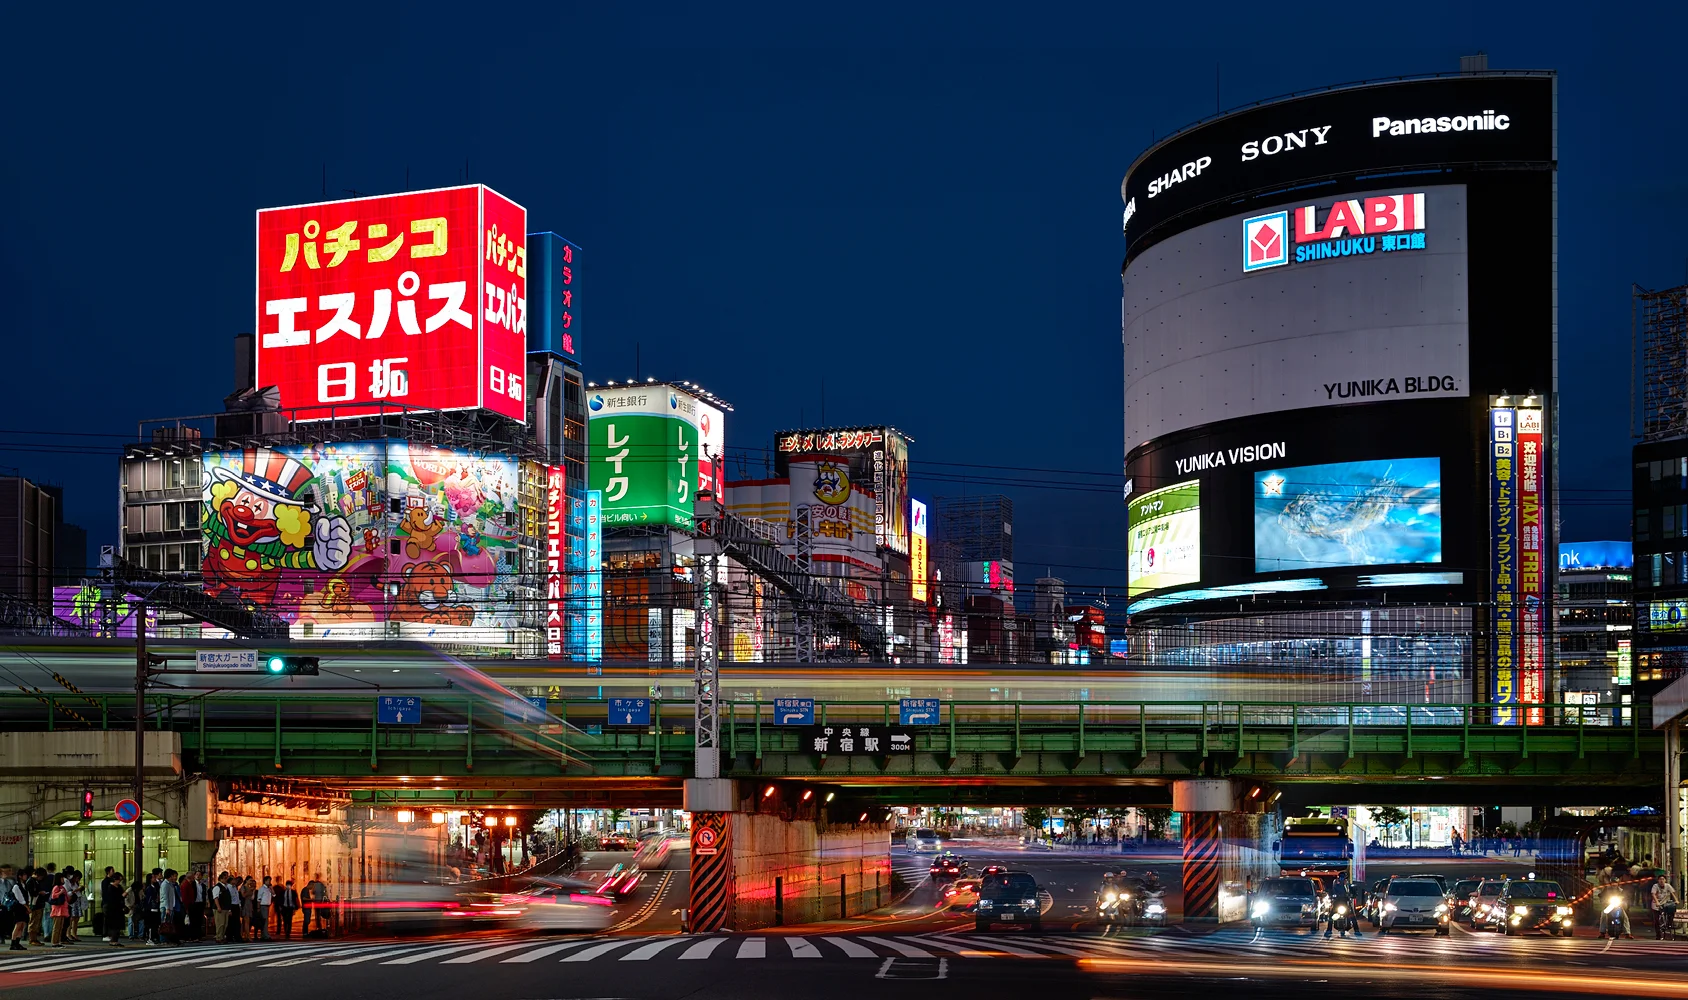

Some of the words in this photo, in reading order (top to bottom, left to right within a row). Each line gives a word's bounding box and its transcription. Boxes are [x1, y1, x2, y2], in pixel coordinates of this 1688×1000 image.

[1241, 125, 1331, 162] SONY
[1147, 156, 1212, 199] SHARP
[1295, 192, 1425, 244] LABI
[280, 217, 448, 272] パチンコ
[486, 223, 525, 278] パチンコ
[1296, 236, 1375, 263] SHINJUKU
[1381, 232, 1426, 252] 東口館
[263, 270, 473, 348] エスパス
[485, 282, 525, 337] エスパス
[317, 357, 409, 403] 日拓
[490, 364, 522, 402] 日拓
[1323, 377, 1400, 400] YUNIKA
[1404, 375, 1459, 394] BLDG.
[607, 395, 647, 408] 新生銀行
[678, 399, 696, 417] 新生銀行
[1498, 430, 1509, 439] B1
[1498, 446, 1510, 454] B2
[605, 424, 630, 502] レイク
[677, 425, 689, 503] レイク
[1175, 451, 1226, 476] YUNIKA
[1228, 441, 1286, 465] VISION
[1523, 440, 1537, 492] 欢迎光临
[1140, 499, 1164, 517] アントマン
[1523, 493, 1539, 525] TAX
[1523, 551, 1539, 592] FREE
[199, 653, 256, 663] 新宿大ガード西
[777, 699, 800, 708] 新宿駅
[902, 699, 925, 708] 新宿駅
[814, 737, 880, 752] 新宿駅
[824, 727, 870, 737] 中央線
